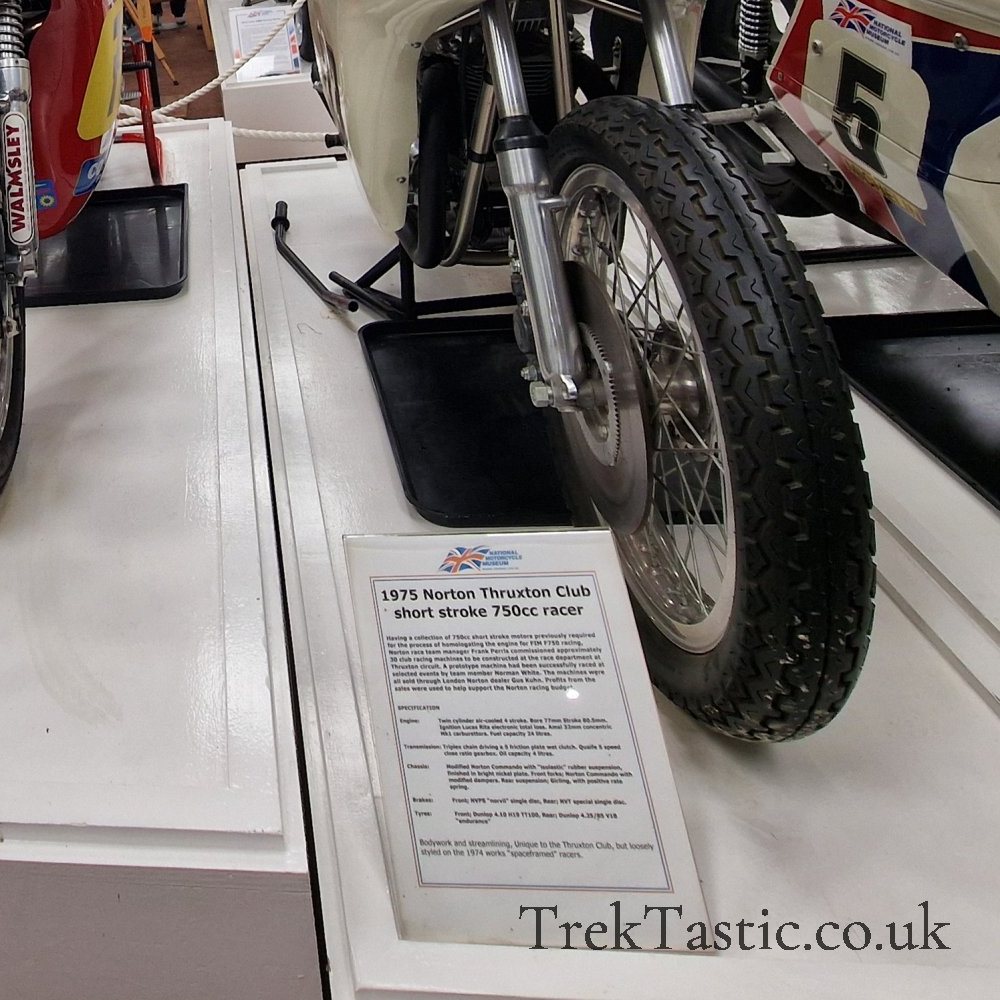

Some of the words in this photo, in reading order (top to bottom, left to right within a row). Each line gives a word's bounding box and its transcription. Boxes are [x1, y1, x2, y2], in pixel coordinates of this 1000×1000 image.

[866, 30, 890, 45] MUSEUM
[868, 24, 906, 46] MOTORCYCLE
[873, 20, 902, 38] NATIONAL
[833, 47, 889, 177] 5
[5, 124, 26, 233] WALMSLEY
[381, 588, 418, 602] 1975
[423, 588, 476, 601] Norton
[479, 586, 551, 600] Thruxton
[555, 584, 591, 598] Club
[394, 606, 435, 619] short
[439, 605, 488, 618] stroke
[491, 604, 539, 618] 750cc
[542, 604, 584, 617] racer
